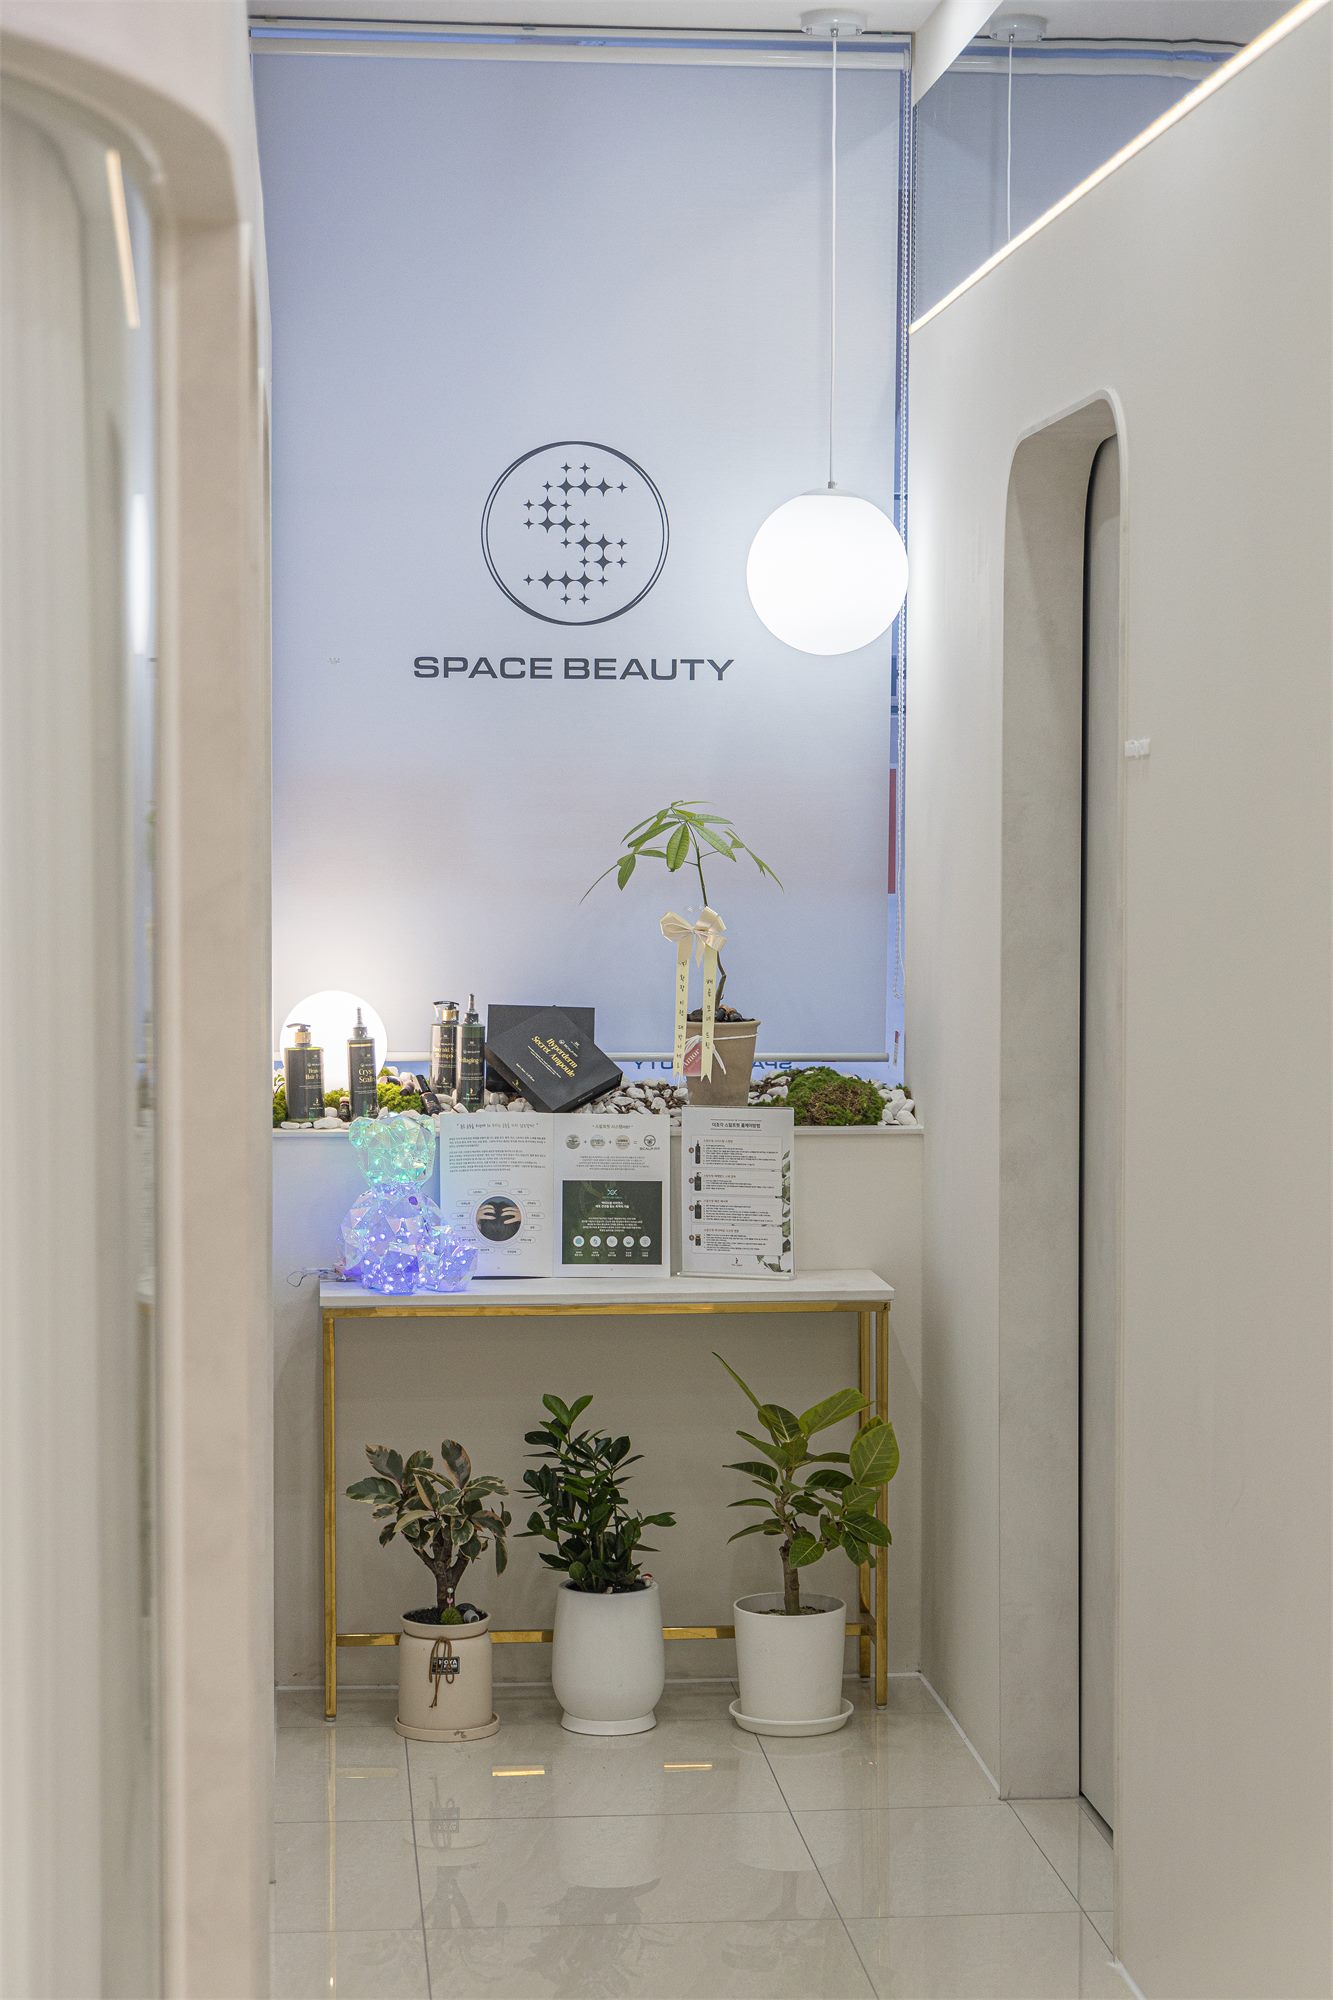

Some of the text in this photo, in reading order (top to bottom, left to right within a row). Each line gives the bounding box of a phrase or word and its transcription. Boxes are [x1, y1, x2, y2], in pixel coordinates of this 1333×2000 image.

[413, 656, 735, 681] SPACE BEAUTY
[531, 1035, 551, 1055] Secret
[550, 1053, 576, 1078] Ampoule
[546, 1038, 578, 1069] Hyperderm
